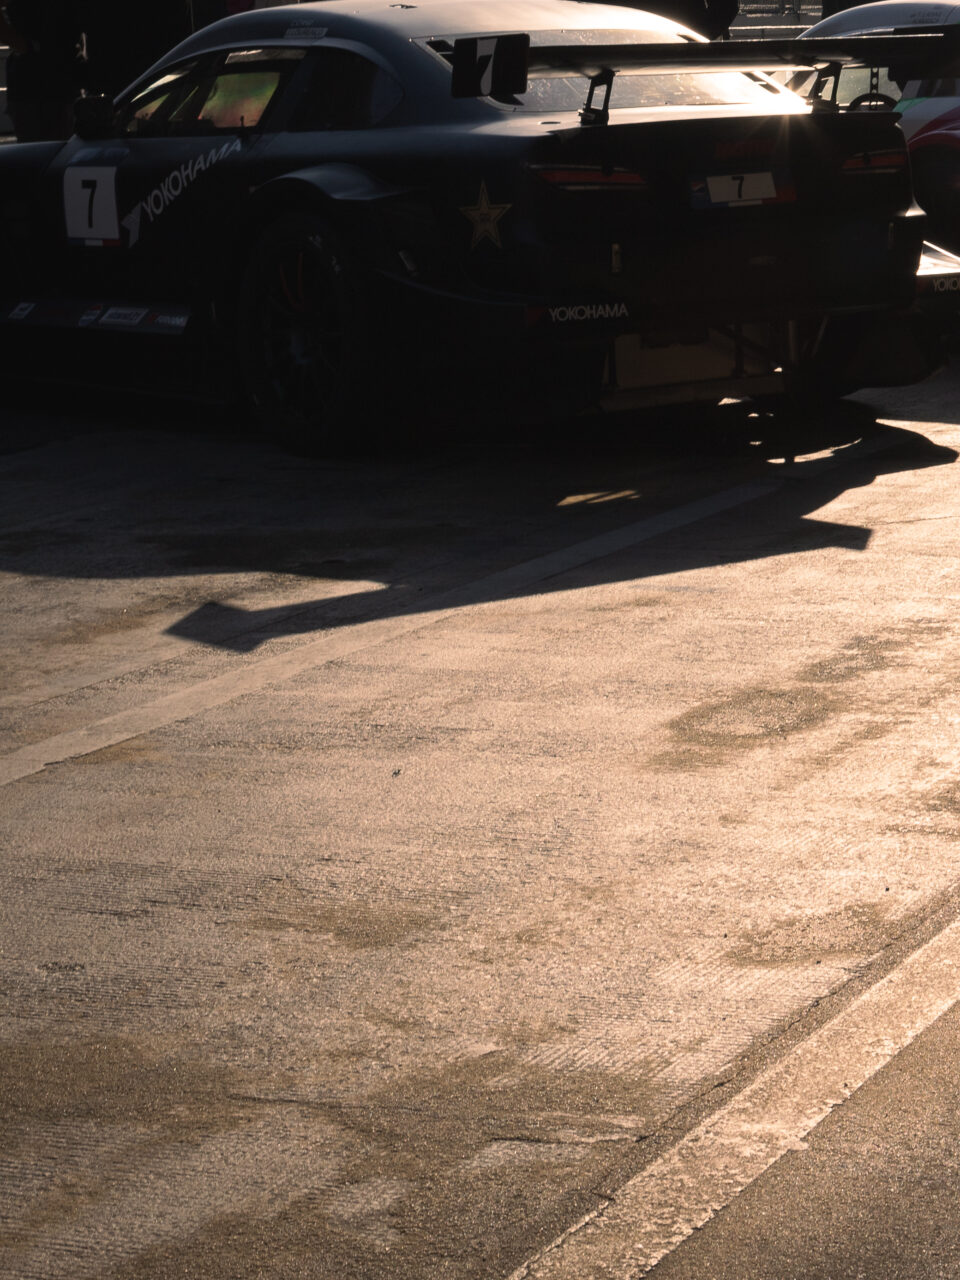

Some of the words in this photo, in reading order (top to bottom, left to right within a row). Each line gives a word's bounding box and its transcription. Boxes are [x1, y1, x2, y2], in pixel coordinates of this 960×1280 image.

[476, 37, 498, 95] 7
[81, 180, 97, 228] 7
[141, 138, 242, 224] YOKOHAMA
[731, 176, 745, 199] 7
[548, 302, 629, 323] YOKOHAMA
